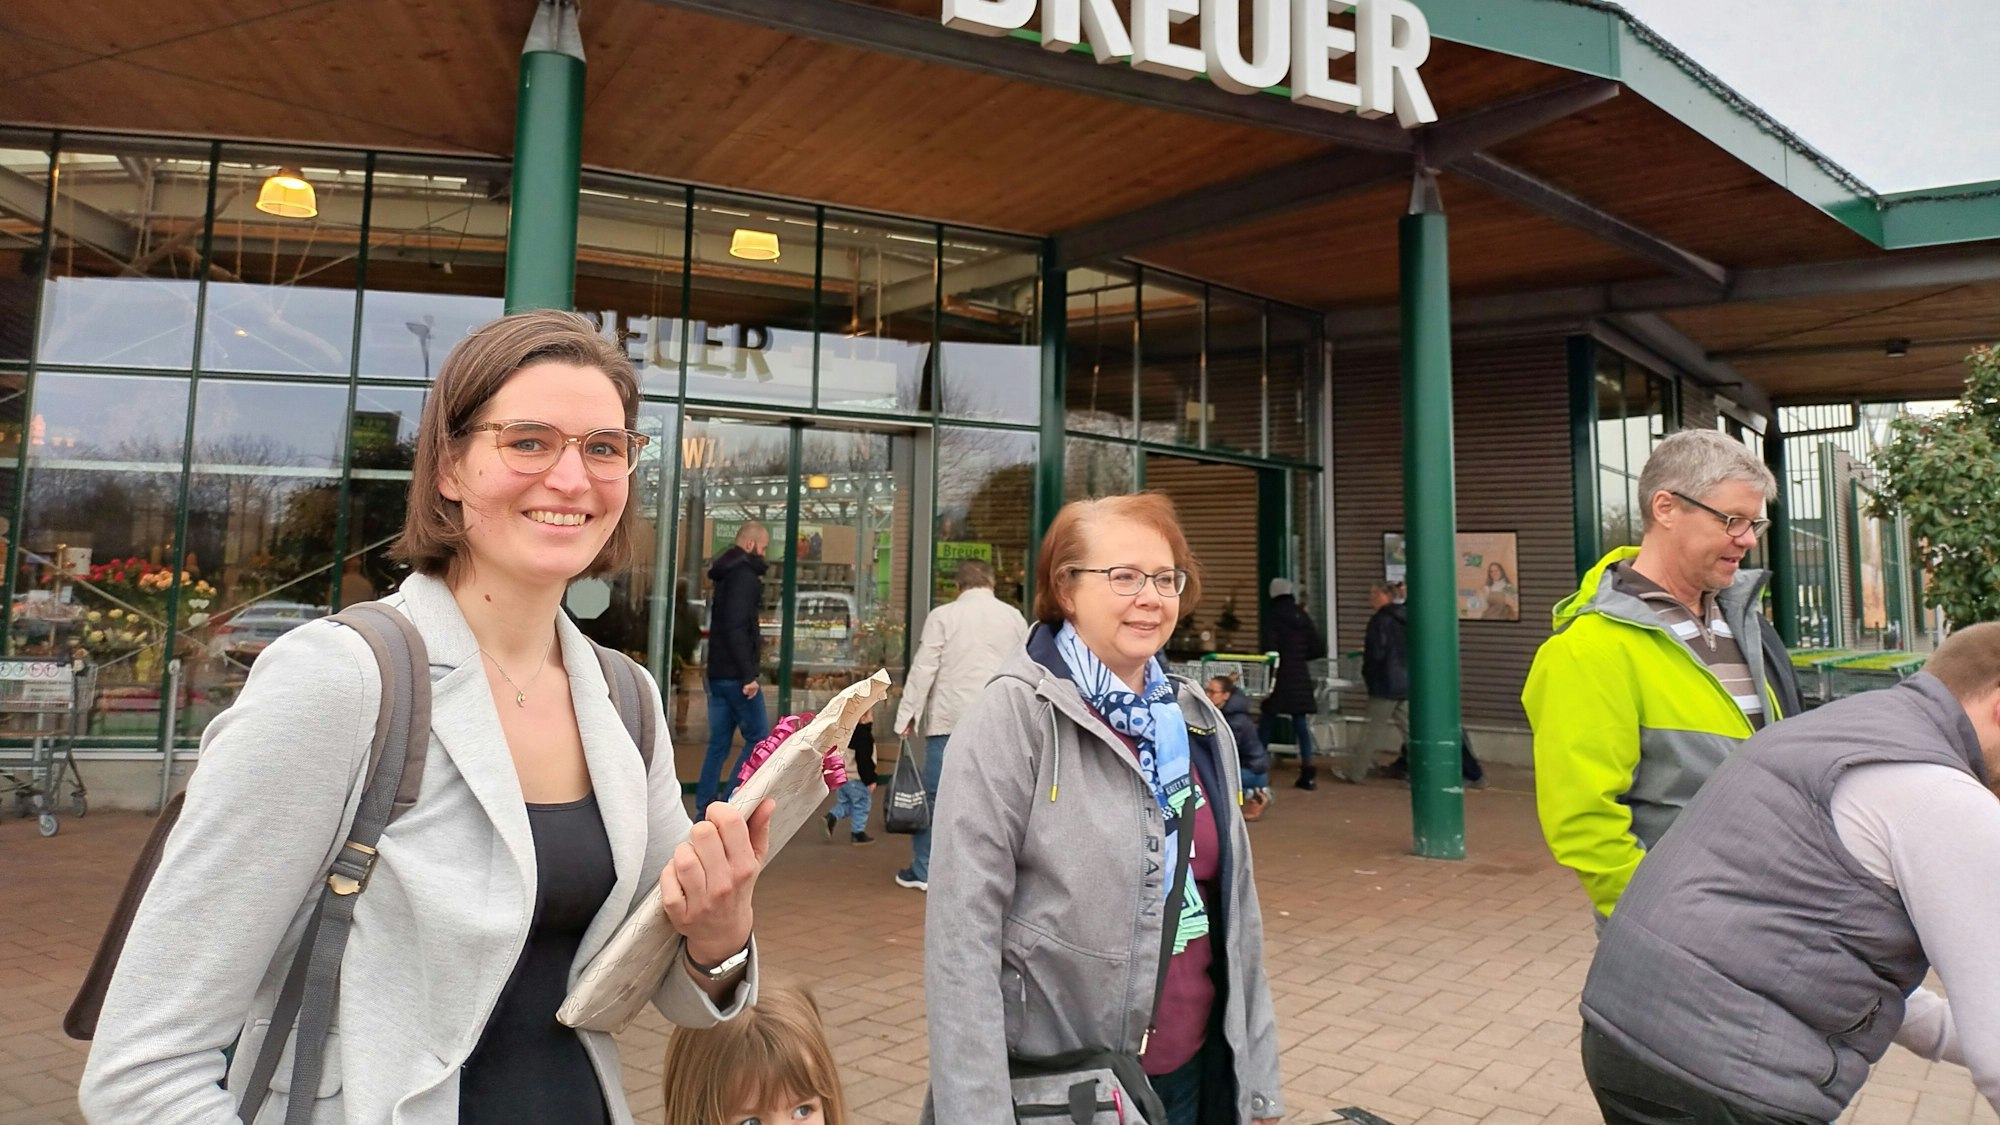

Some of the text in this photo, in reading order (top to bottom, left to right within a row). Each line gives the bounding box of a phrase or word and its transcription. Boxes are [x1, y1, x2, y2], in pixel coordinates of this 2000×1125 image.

[942, 0, 1438, 128] EUER
[589, 308, 774, 384] EUER
[943, 544, 987, 557] Breuer
